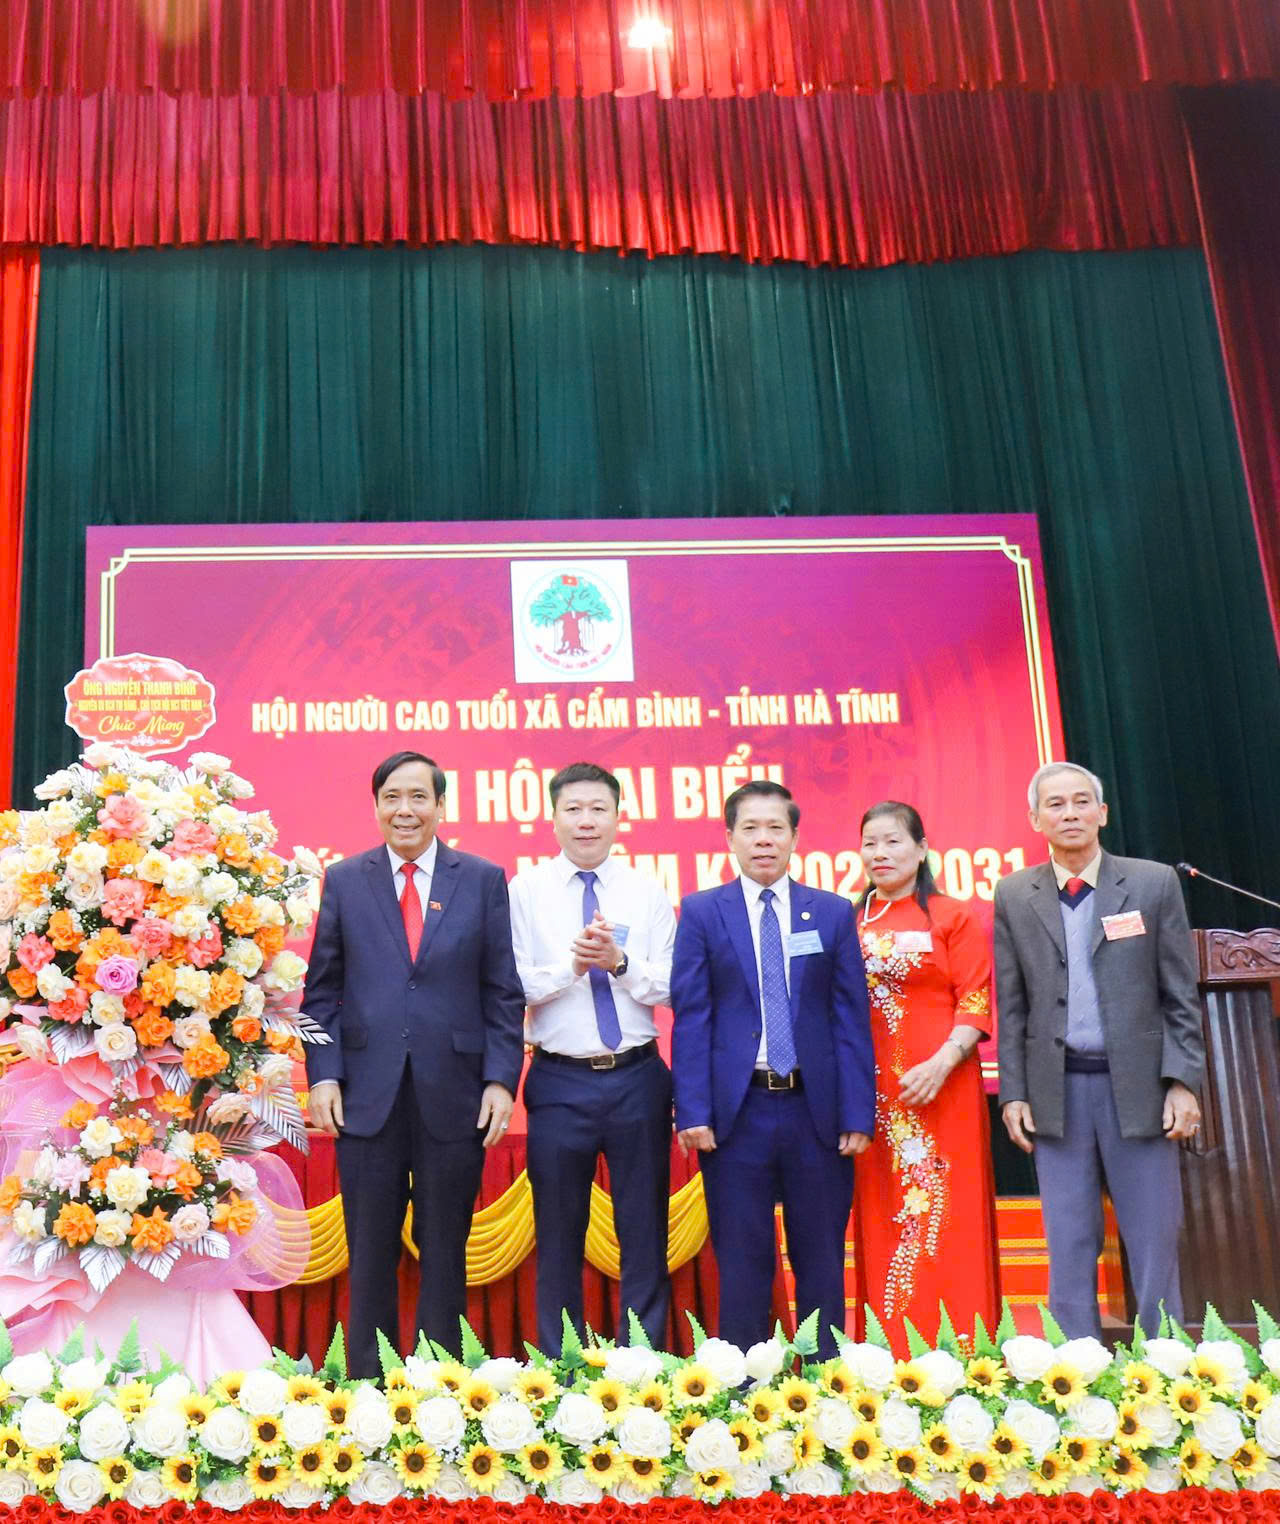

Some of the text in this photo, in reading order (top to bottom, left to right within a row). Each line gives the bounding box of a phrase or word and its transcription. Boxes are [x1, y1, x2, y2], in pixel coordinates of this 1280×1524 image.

[98, 714, 136, 734] Chúc
[252, 696, 297, 739] HỘI
[305, 694, 387, 732] NGƯỜI
[395, 700, 449, 731] CAO
[456, 688, 517, 731] TUỔI
[524, 694, 562, 730] XÃ
[567, 687, 629, 728] CẨM
[636, 691, 701, 728] BÌNH
[725, 686, 788, 726] TỈNH
[793, 688, 832, 726] HÀ
[836, 688, 899, 724] TĨNH
[613, 767, 657, 833] ẠI
